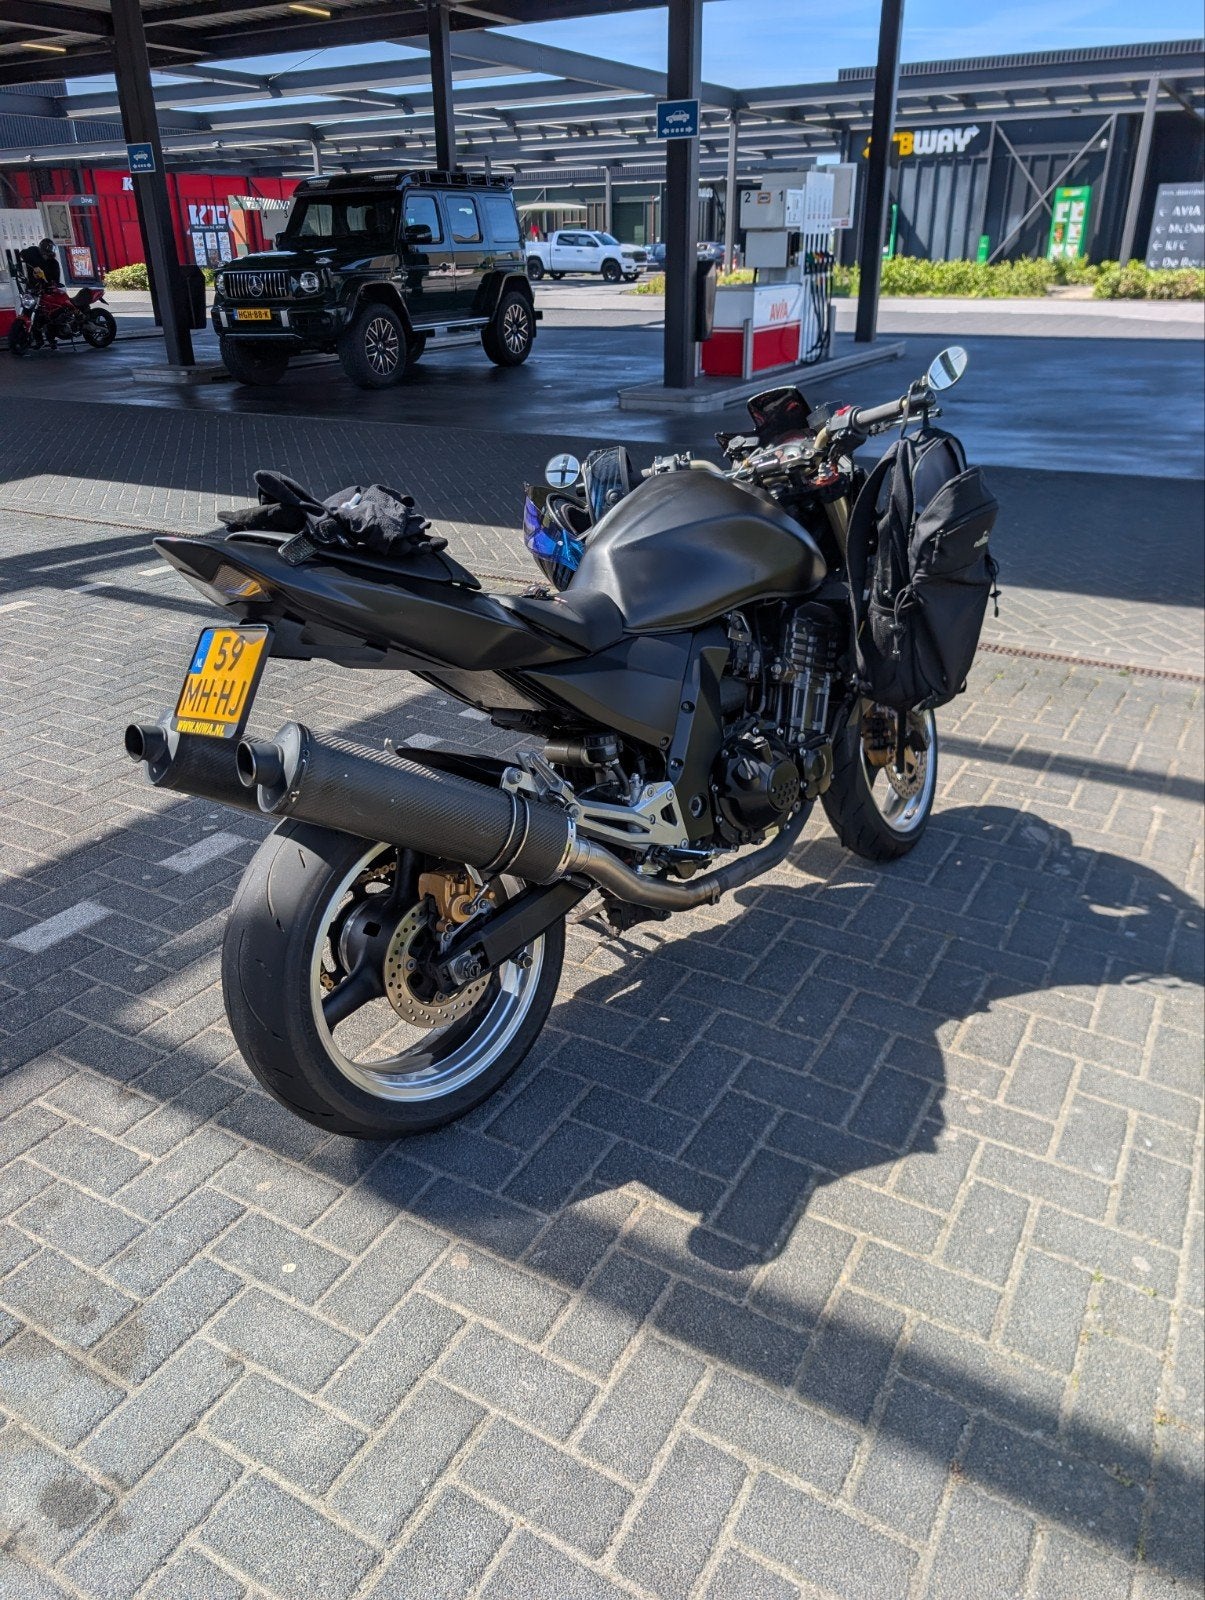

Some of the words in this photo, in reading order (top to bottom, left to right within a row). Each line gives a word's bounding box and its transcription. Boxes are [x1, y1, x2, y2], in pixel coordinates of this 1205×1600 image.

[744, 192, 751, 203] 2
[778, 190, 784, 202] 1
[770, 300, 787, 320] AVIA
[214, 635, 246, 671] 59
